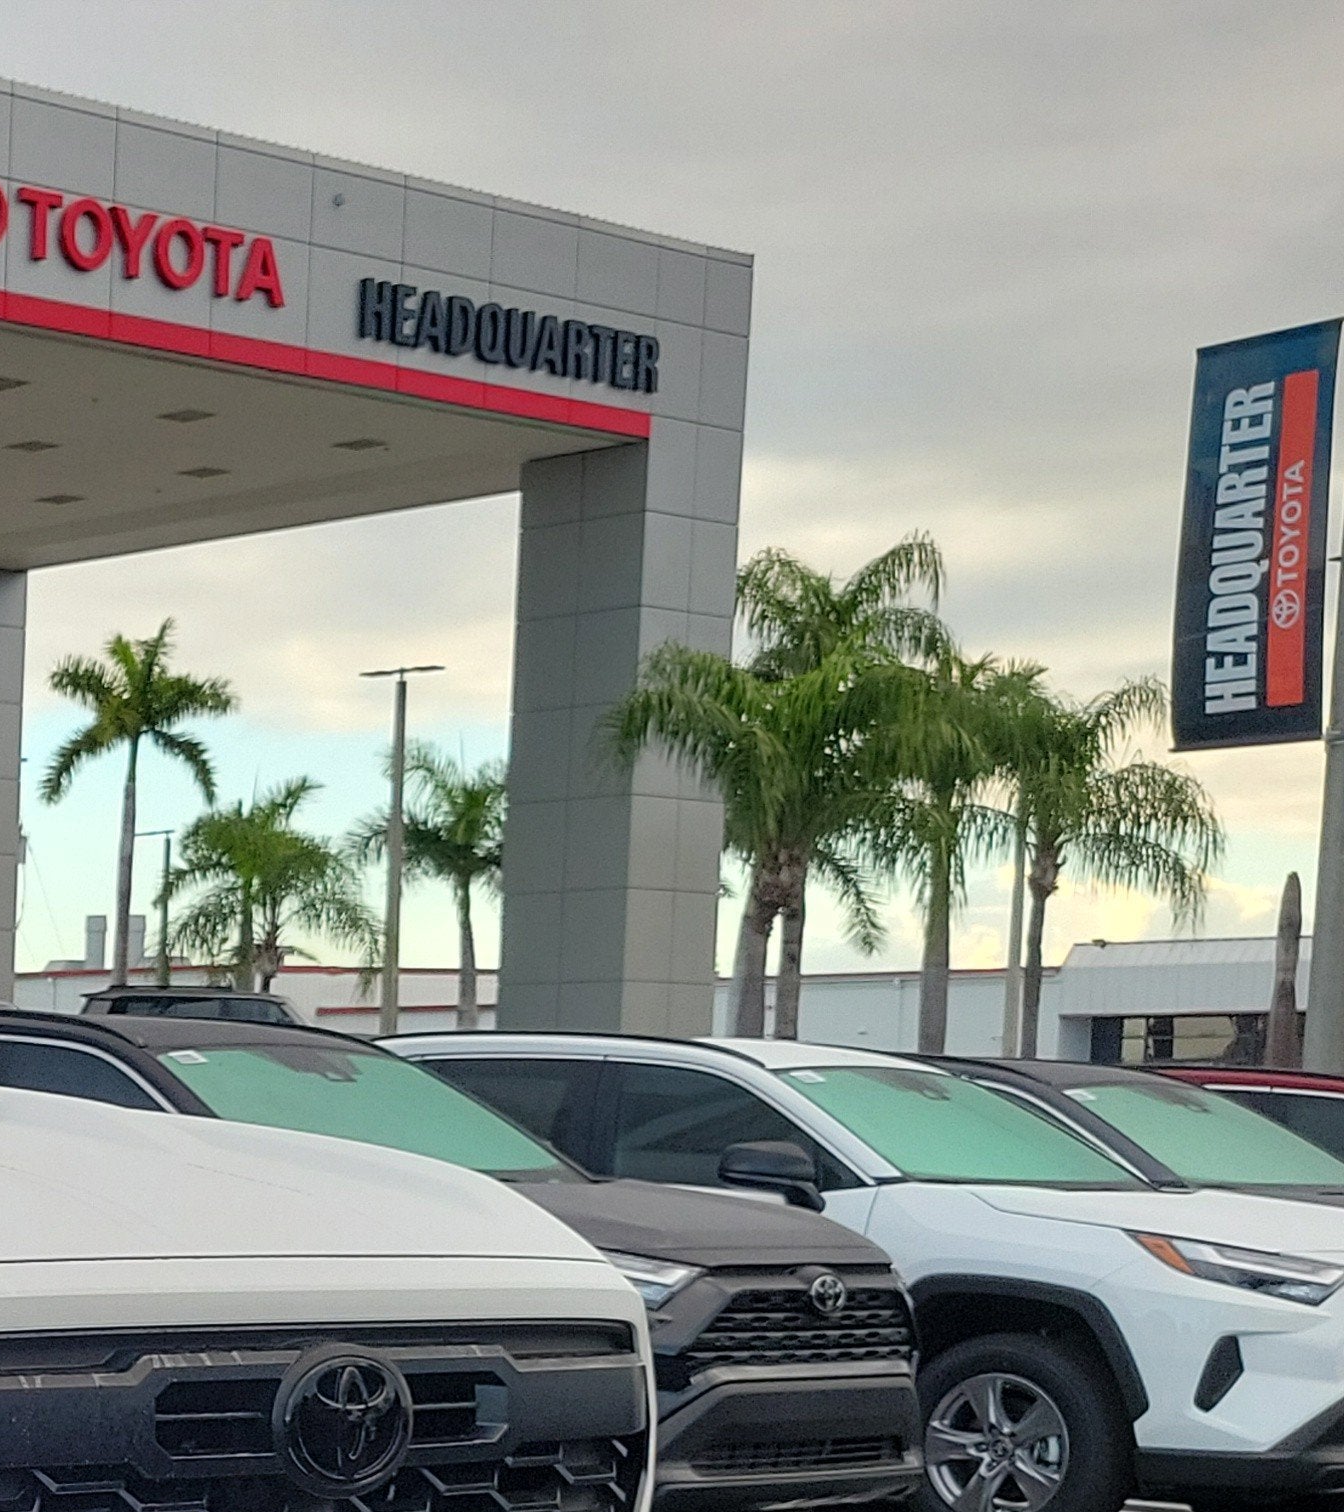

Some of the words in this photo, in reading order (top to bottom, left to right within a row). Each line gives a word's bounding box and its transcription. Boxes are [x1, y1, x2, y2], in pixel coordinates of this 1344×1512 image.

[17, 186, 285, 308] TOYOTA
[358, 276, 660, 395] HEADQUARTER
[1204, 380, 1276, 715] HEADQUARTER
[1276, 459, 1306, 588] TOYOTA
